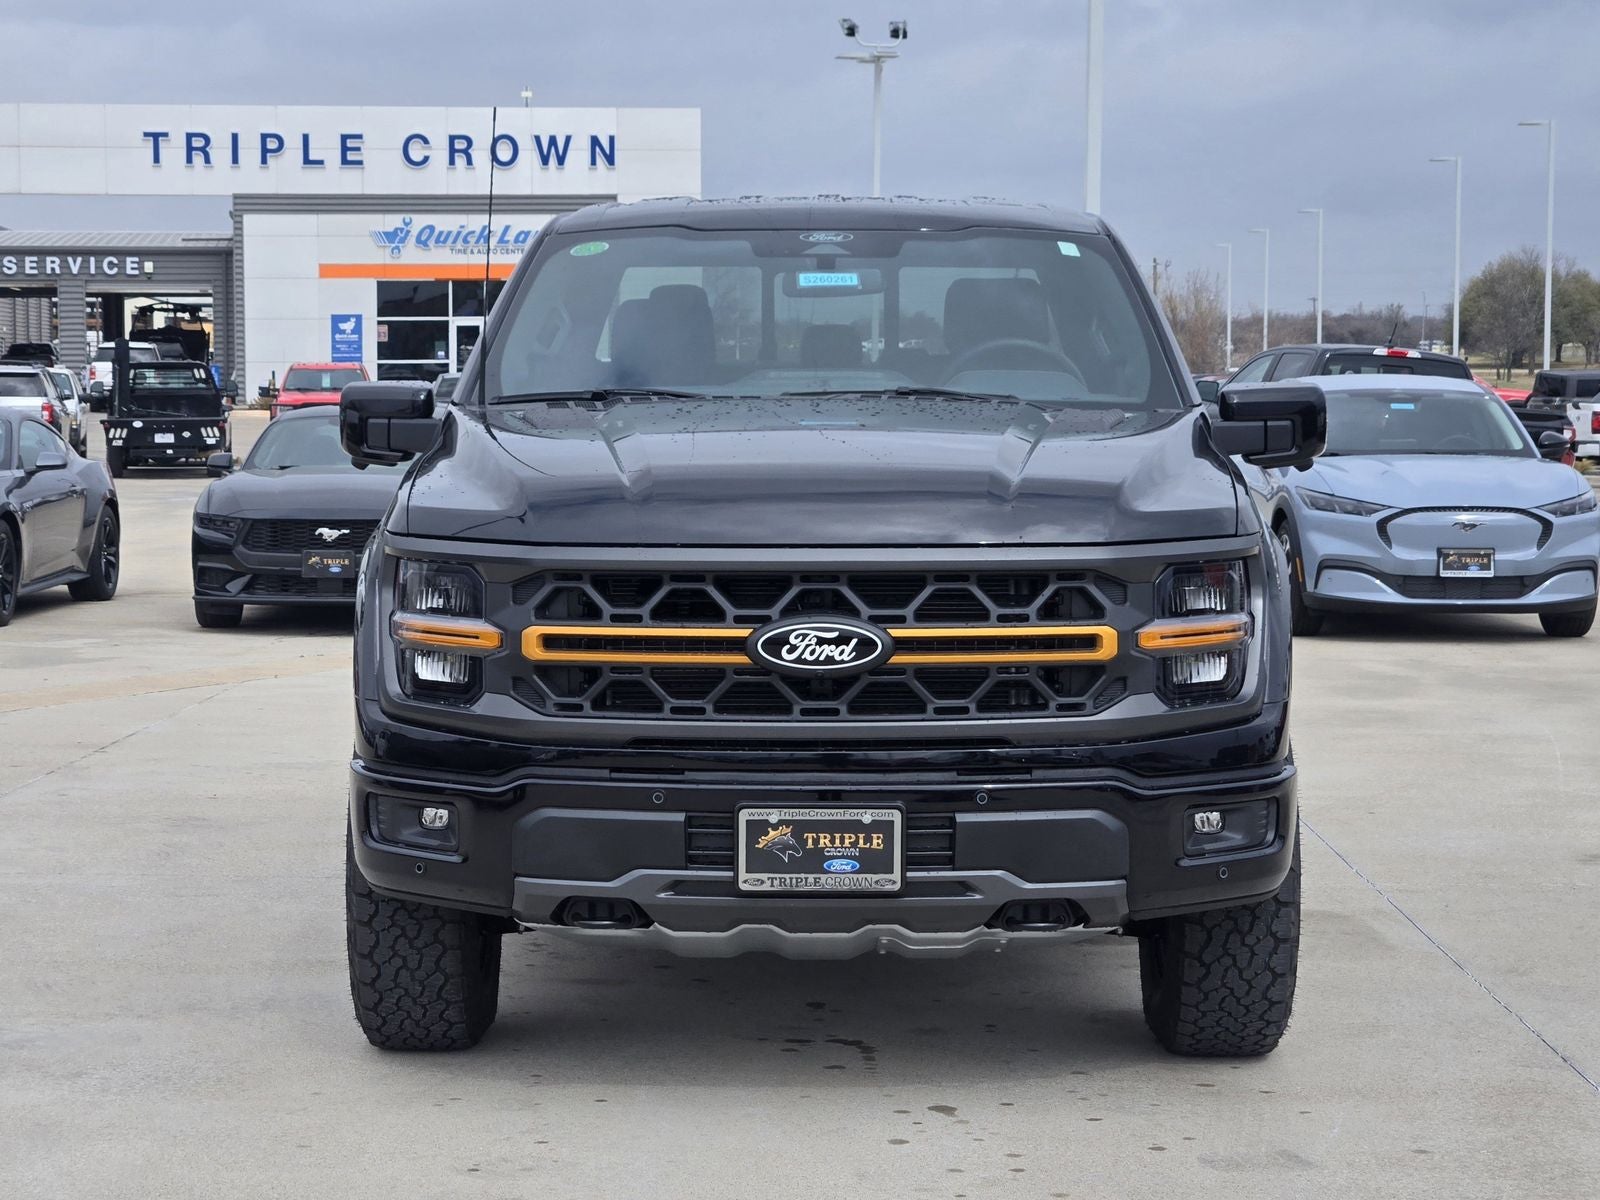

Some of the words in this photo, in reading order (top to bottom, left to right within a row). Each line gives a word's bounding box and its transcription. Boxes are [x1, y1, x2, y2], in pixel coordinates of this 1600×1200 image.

[142, 130, 365, 167] TRIPLE
[401, 132, 617, 168] CROWN
[415, 224, 493, 248] Quick
[496, 224, 540, 245] La
[2, 256, 140, 275] SERVICE
[803, 275, 853, 284] S260261
[781, 629, 858, 661] Ford
[747, 809, 894, 818] wwwTripleCrownFordcom
[803, 833, 884, 850] TRIPLE
[823, 847, 860, 856] CROWN
[767, 876, 822, 888] TRIPLE
[824, 876, 873, 888] CROWN
